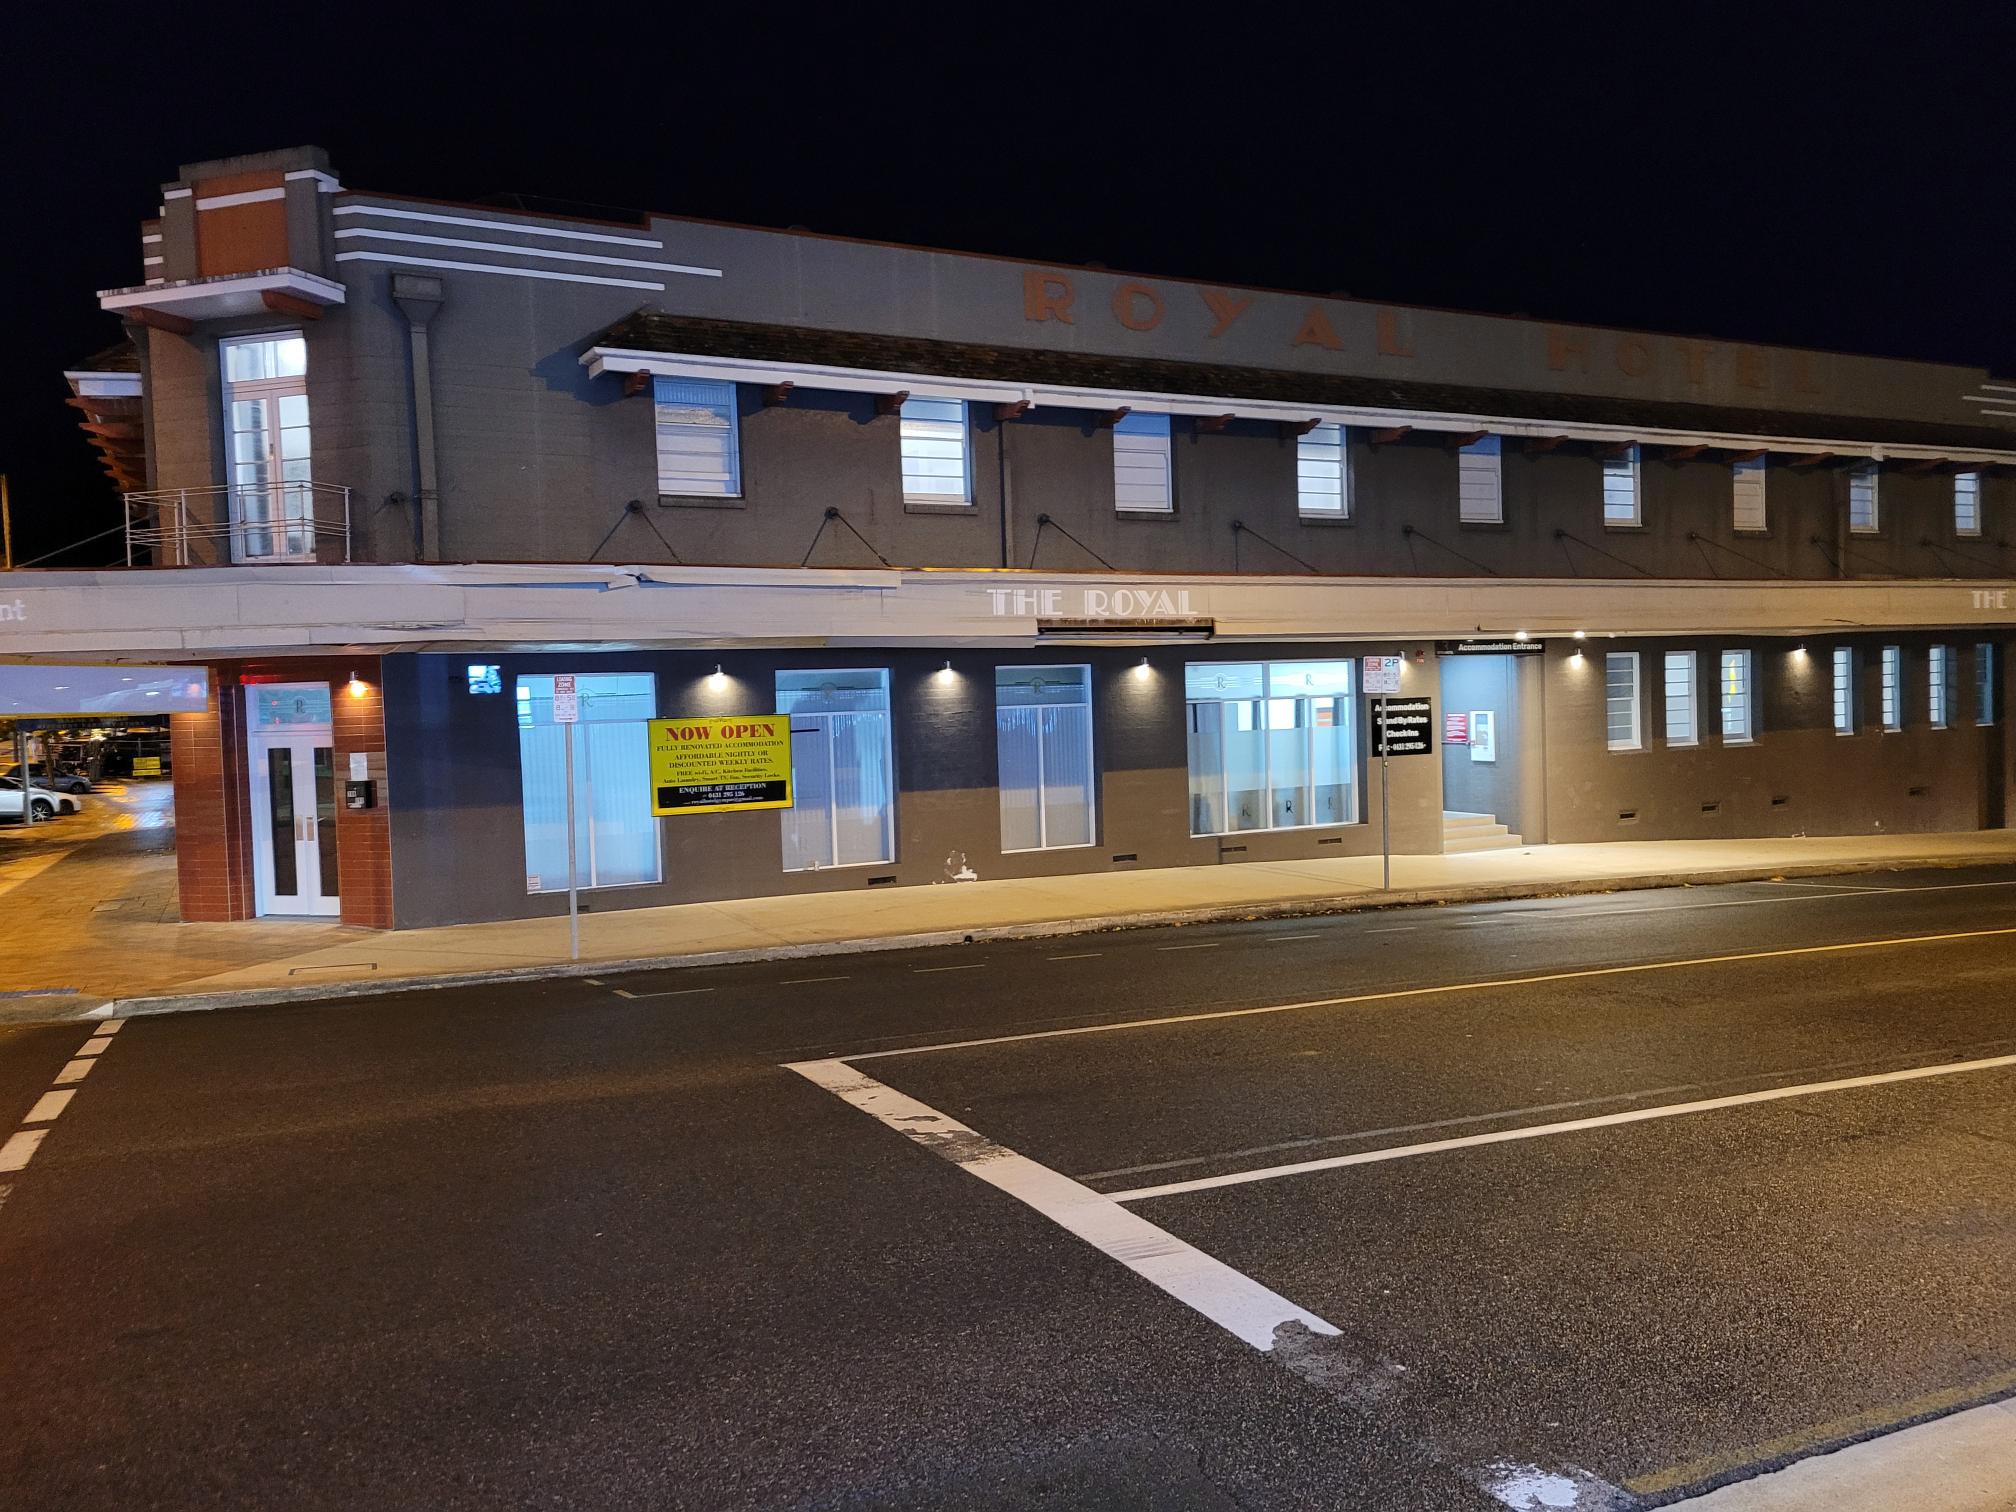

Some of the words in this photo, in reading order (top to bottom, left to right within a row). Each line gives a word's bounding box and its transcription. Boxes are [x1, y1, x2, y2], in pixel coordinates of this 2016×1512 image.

[1024, 271, 1413, 357] ROYAL
[1548, 325, 1823, 394] HOTEL
[986, 588, 1063, 616] THE
[1084, 588, 1199, 616] ROYAL
[1971, 590, 2008, 609] THE
[1458, 642, 1512, 651] Accommodation
[1512, 642, 1543, 651] Entrance
[1384, 658, 1399, 667] 2P
[665, 726, 711, 741] NOW
[721, 723, 775, 739] OPEN
[656, 744, 678, 752] FULLY
[680, 742, 722, 751] RENOVATED
[725, 739, 784, 749] ACCOMMODATION
[675, 752, 722, 760] AFFORDABLE
[725, 750, 754, 759] NIGHTLY
[757, 749, 768, 757] OR
[669, 760, 717, 769] DISCOUNTED
[719, 757, 748, 766] WEEKLY
[679, 785, 713, 795] ENQUIRE
[714, 784, 724, 792] AT
[724, 782, 767, 791] RECEPTION
